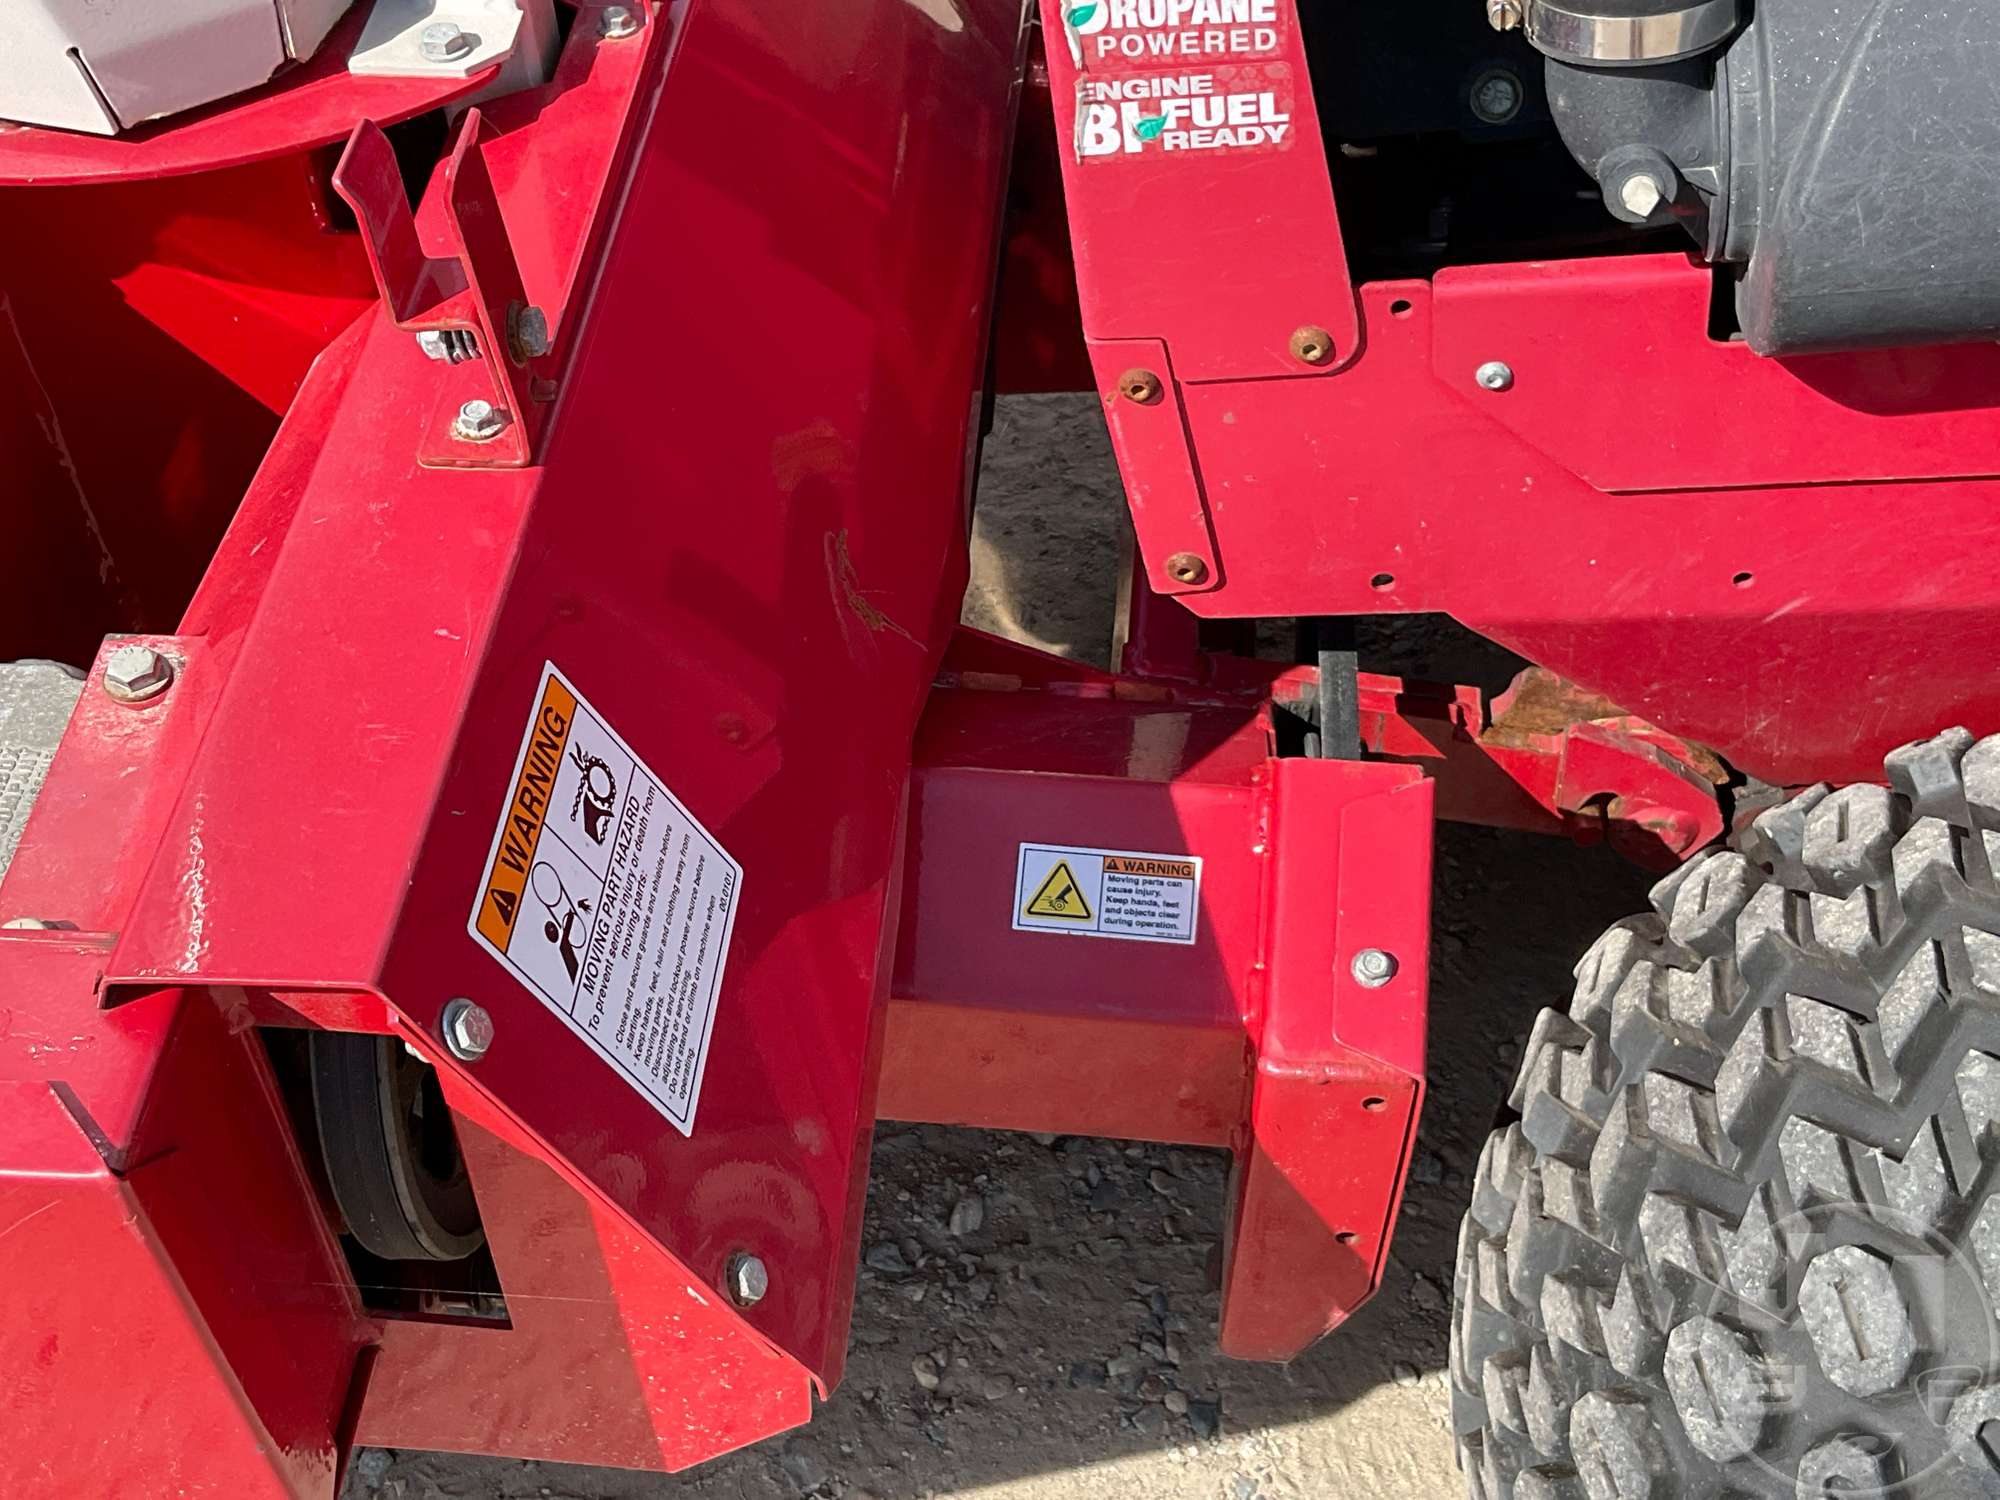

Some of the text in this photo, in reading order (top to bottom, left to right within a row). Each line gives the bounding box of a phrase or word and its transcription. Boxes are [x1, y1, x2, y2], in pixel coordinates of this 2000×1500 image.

[1097, 28, 1278, 57] POWERED
[1087, 74, 1213, 101] ENGINE
[1083, 92, 1289, 156] BI FUEL
[1163, 124, 1289, 151] READY
[500, 706, 567, 874] WARNING
[718, 871, 732, 913] 00.0101
[1107, 875, 1139, 885] Moving
[1142, 878, 1165, 888] parts
[1123, 860, 1192, 877] WARNING
[1134, 887, 1162, 898] injury.
[582, 795, 640, 996] MOVING PART HAZARD
[587, 785, 656, 1031] To prevent serious injury or death from
[620, 870, 648, 960] moving parts:
[1105, 906, 1180, 920] and objects clear
[1106, 896, 1180, 908] Keep hands, feet
[615, 823, 672, 1044] Close and secure guards and shields before
[632, 833, 690, 1061] Keep hands, feet, hair and clothing away from
[1104, 917, 1179, 930] during operation.
[650, 854, 705, 1078] Disconnect and lockout power source before
[668, 894, 716, 1095] Do not stand or climb on machine when
[626, 1007, 642, 1051] starting.
[643, 996, 665, 1067] moving parts.
[661, 969, 692, 1085] adjusting or servicing.
[678, 1047, 696, 1100] operating.
